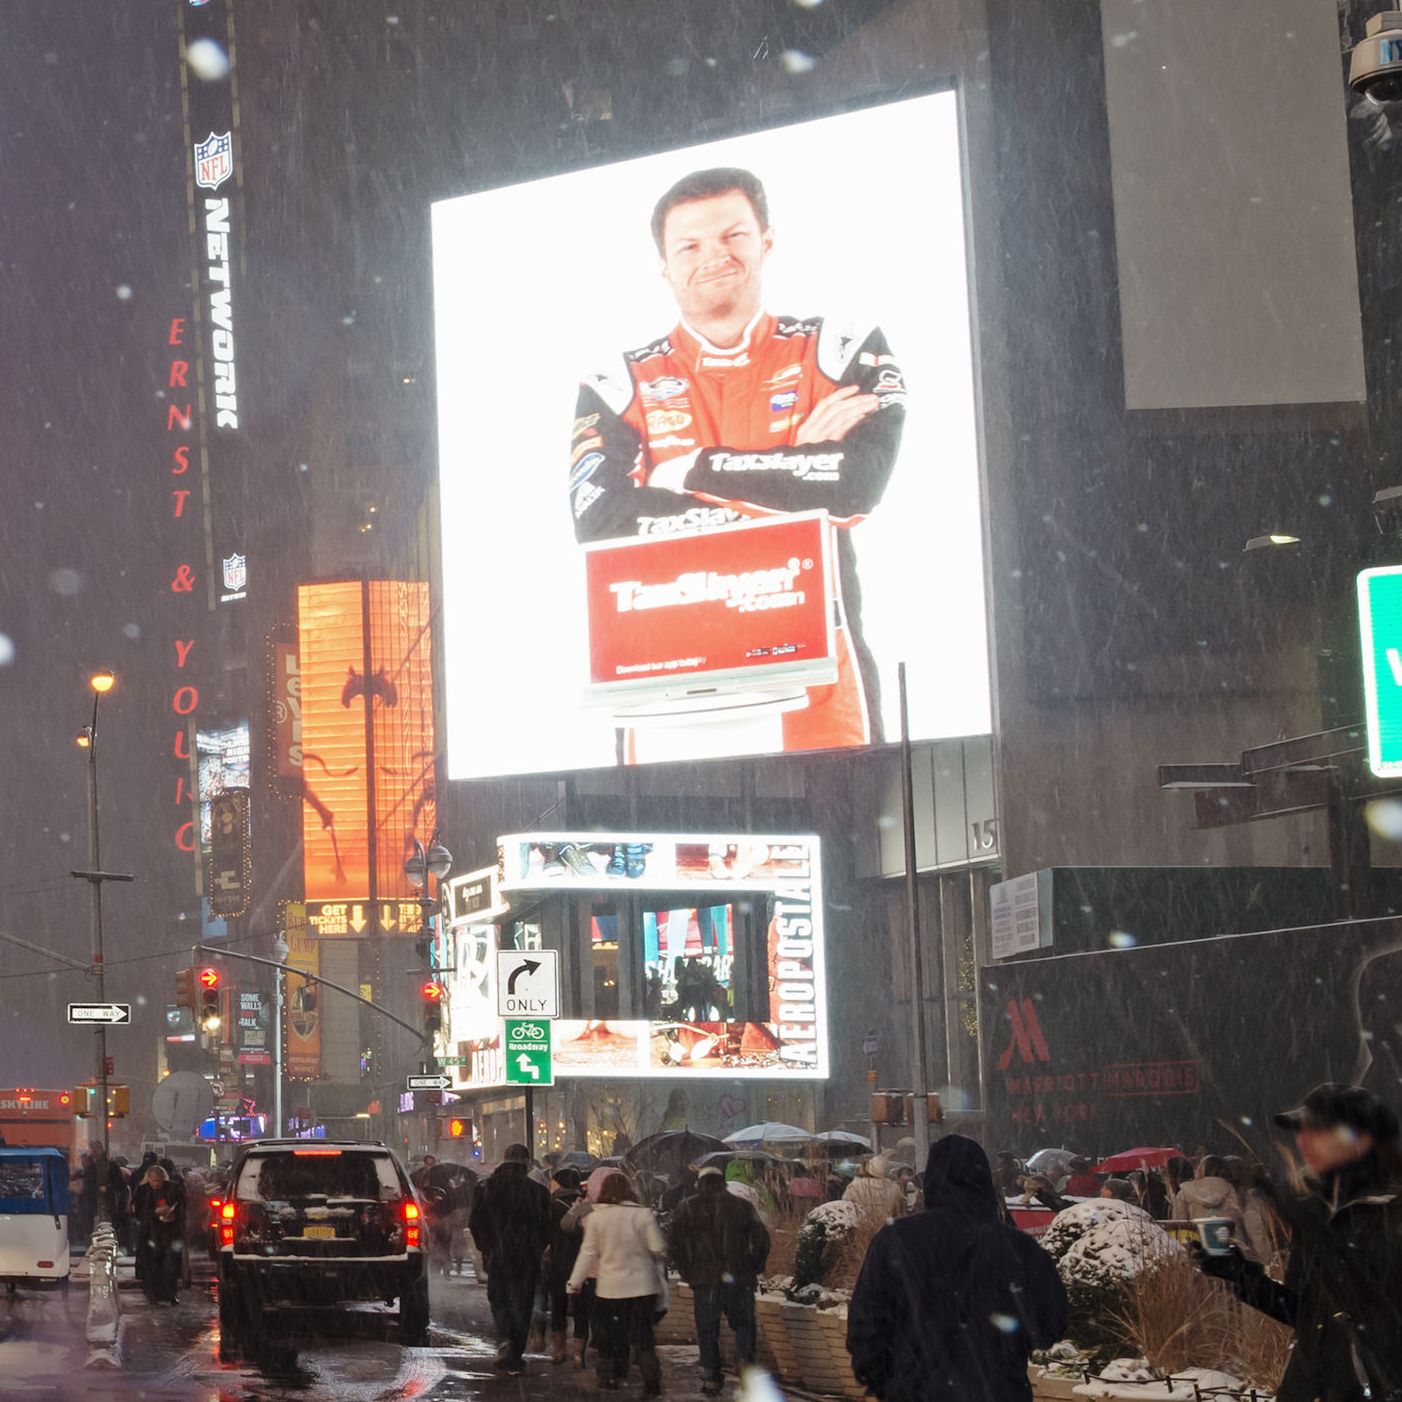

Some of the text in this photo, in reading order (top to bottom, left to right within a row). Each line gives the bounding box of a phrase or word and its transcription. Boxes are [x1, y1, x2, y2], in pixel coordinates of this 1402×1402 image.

[199, 153, 229, 183] NFL
[204, 197, 239, 430] NETWORK
[167, 317, 194, 520] ERNST
[171, 565, 196, 593] &
[226, 569, 246, 585] NFL
[971, 819, 996, 851] 15
[321, 904, 347, 916] GET
[309, 915, 348, 926] TICKETS
[318, 924, 348, 934] HERE
[240, 993, 260, 1002] SOME
[240, 1001, 263, 1011] WALLS
[506, 999, 548, 1012] ONLY
[75, 1008, 122, 1020] ONE WAY
[508, 1043, 548, 1052] Broadway
[413, 1078, 427, 1086] ONE
[0, 1099, 50, 1110] SKYLINE
